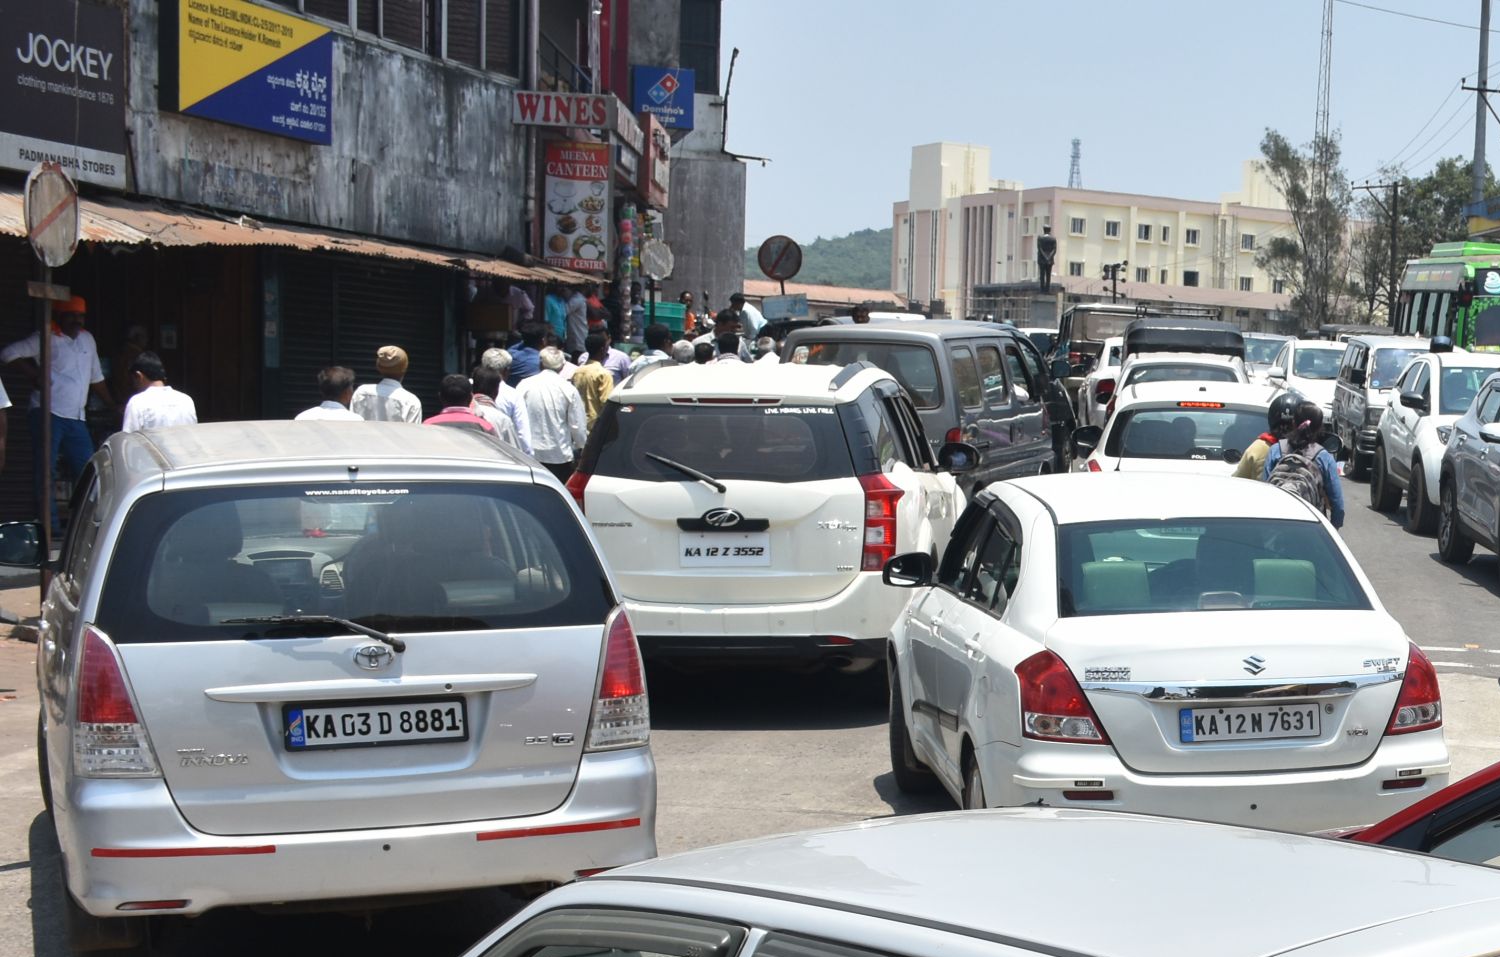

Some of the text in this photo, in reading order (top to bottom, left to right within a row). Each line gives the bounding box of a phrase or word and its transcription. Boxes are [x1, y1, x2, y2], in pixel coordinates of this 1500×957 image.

[17, 32, 113, 81] JOCKEY
[17, 74, 114, 105] clothing mankind since 1876
[516, 92, 607, 127] WINES
[642, 103, 685, 116] Domino's
[560, 150, 596, 161] MEENA
[82, 162, 116, 176] STORES
[546, 161, 609, 178] CANTEEN
[573, 258, 605, 271] CENTRE
[684, 546, 764, 557] KA 12 Z 3552
[305, 714, 338, 739] KA
[377, 711, 393, 735] D
[399, 707, 460, 734] 8881
[1195, 710, 1315, 736] KA 12 N 7631
